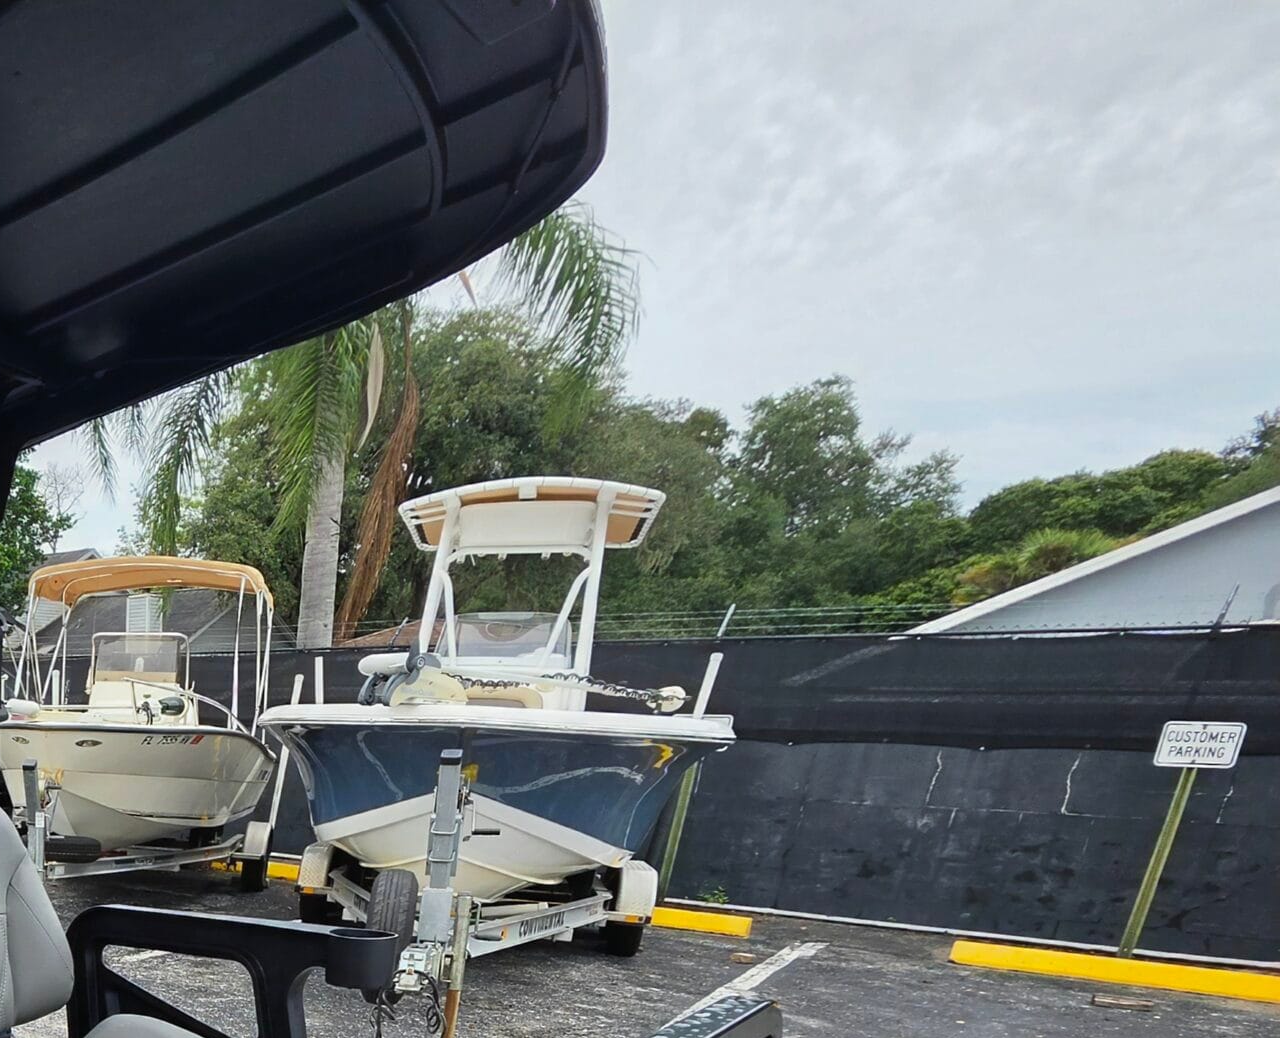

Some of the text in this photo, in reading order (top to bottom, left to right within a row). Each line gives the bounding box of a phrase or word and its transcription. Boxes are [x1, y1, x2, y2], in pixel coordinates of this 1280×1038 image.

[141, 735, 154, 745] FL
[1166, 730, 1237, 744] CUSTOMER
[1167, 745, 1225, 759] PARKING
